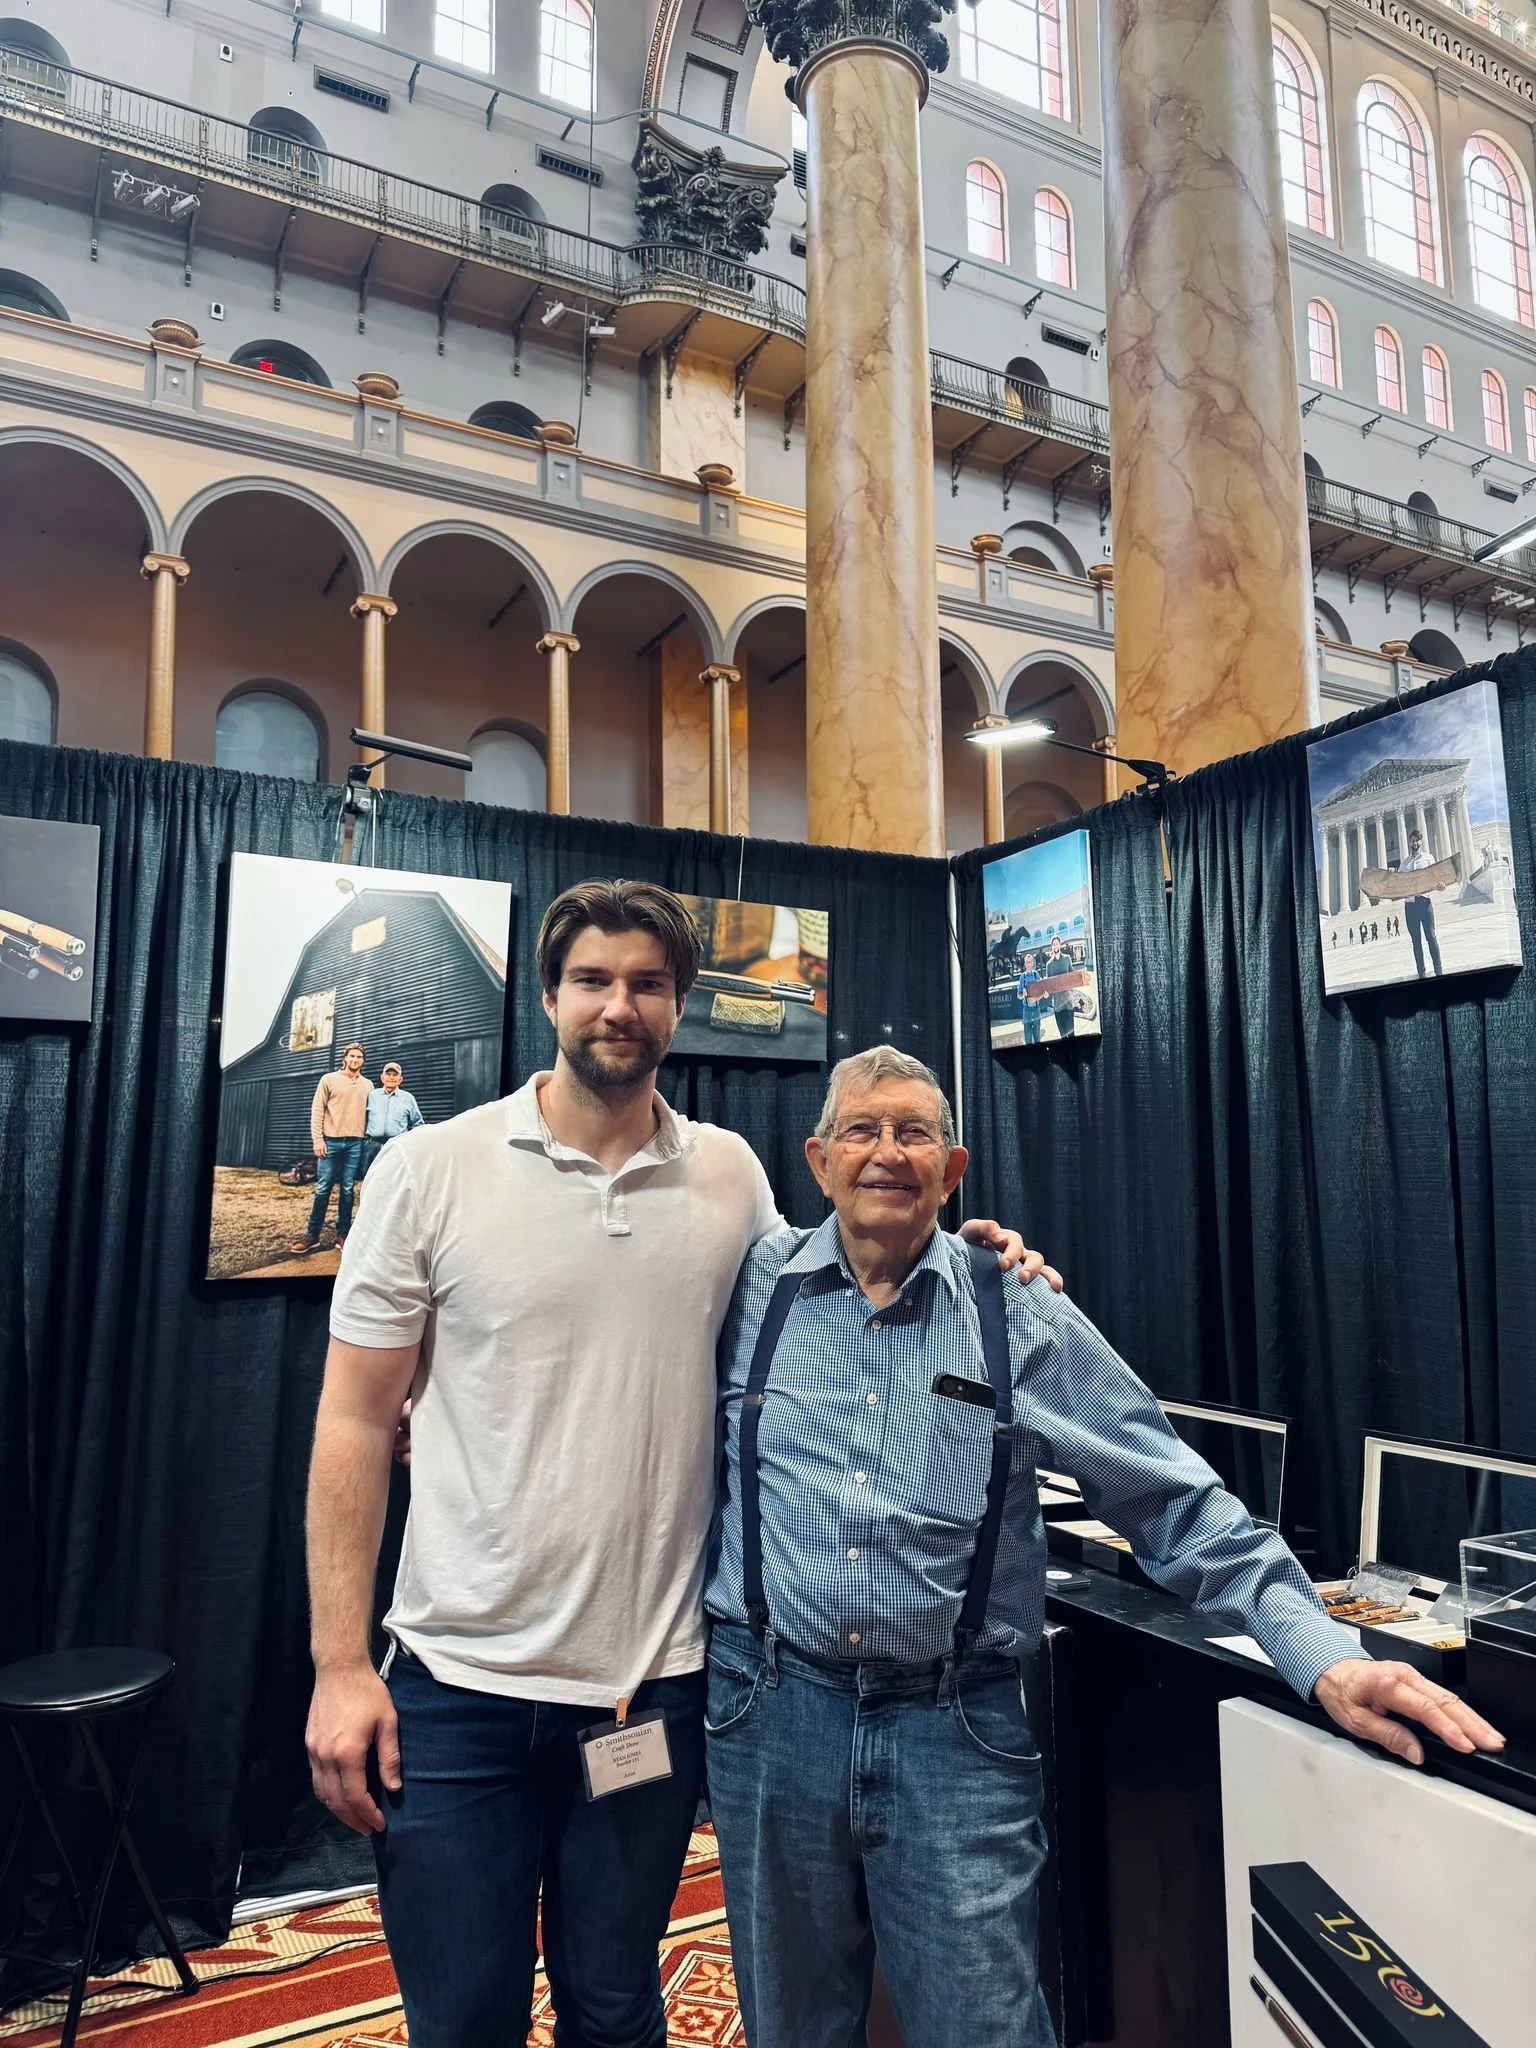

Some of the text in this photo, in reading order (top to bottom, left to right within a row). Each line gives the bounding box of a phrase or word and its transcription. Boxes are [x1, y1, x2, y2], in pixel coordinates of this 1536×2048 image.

[605, 1728, 652, 1746] Smithsonian
[612, 1741, 640, 1753] Craft Show
